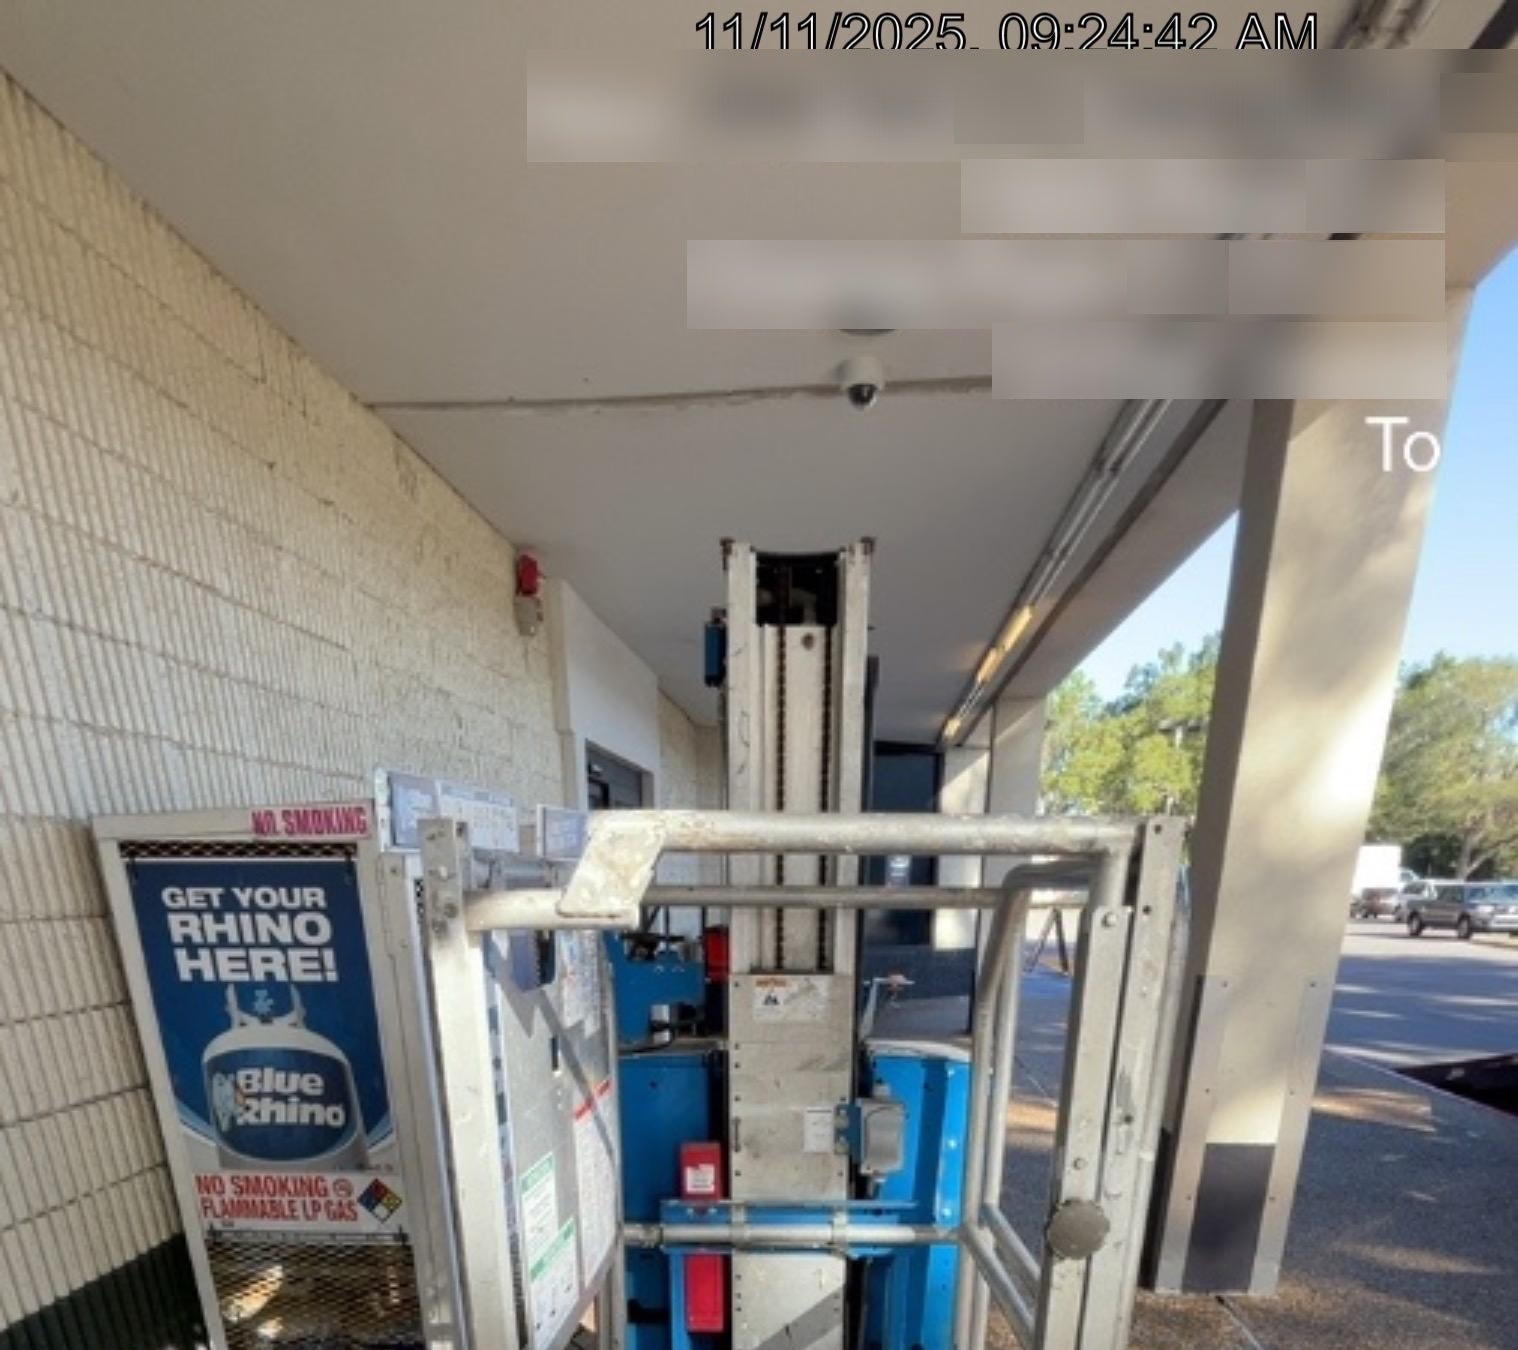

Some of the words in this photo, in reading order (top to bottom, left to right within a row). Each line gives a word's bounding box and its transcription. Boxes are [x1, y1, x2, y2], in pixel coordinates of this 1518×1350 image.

[281, 806, 367, 835] SMOKING
[161, 886, 224, 909] GET
[231, 886, 327, 909] YOUR
[167, 911, 332, 944] RHINO
[174, 948, 338, 982] HERE!
[236, 1067, 324, 1096] Blue
[236, 1096, 346, 1127] Rhino
[195, 1175, 225, 1195] NO
[230, 1175, 327, 1198] SMOKING
[202, 1199, 298, 1220] FLAMMABLE
[303, 1201, 321, 1220] LP
[324, 1201, 358, 1222] GAS
